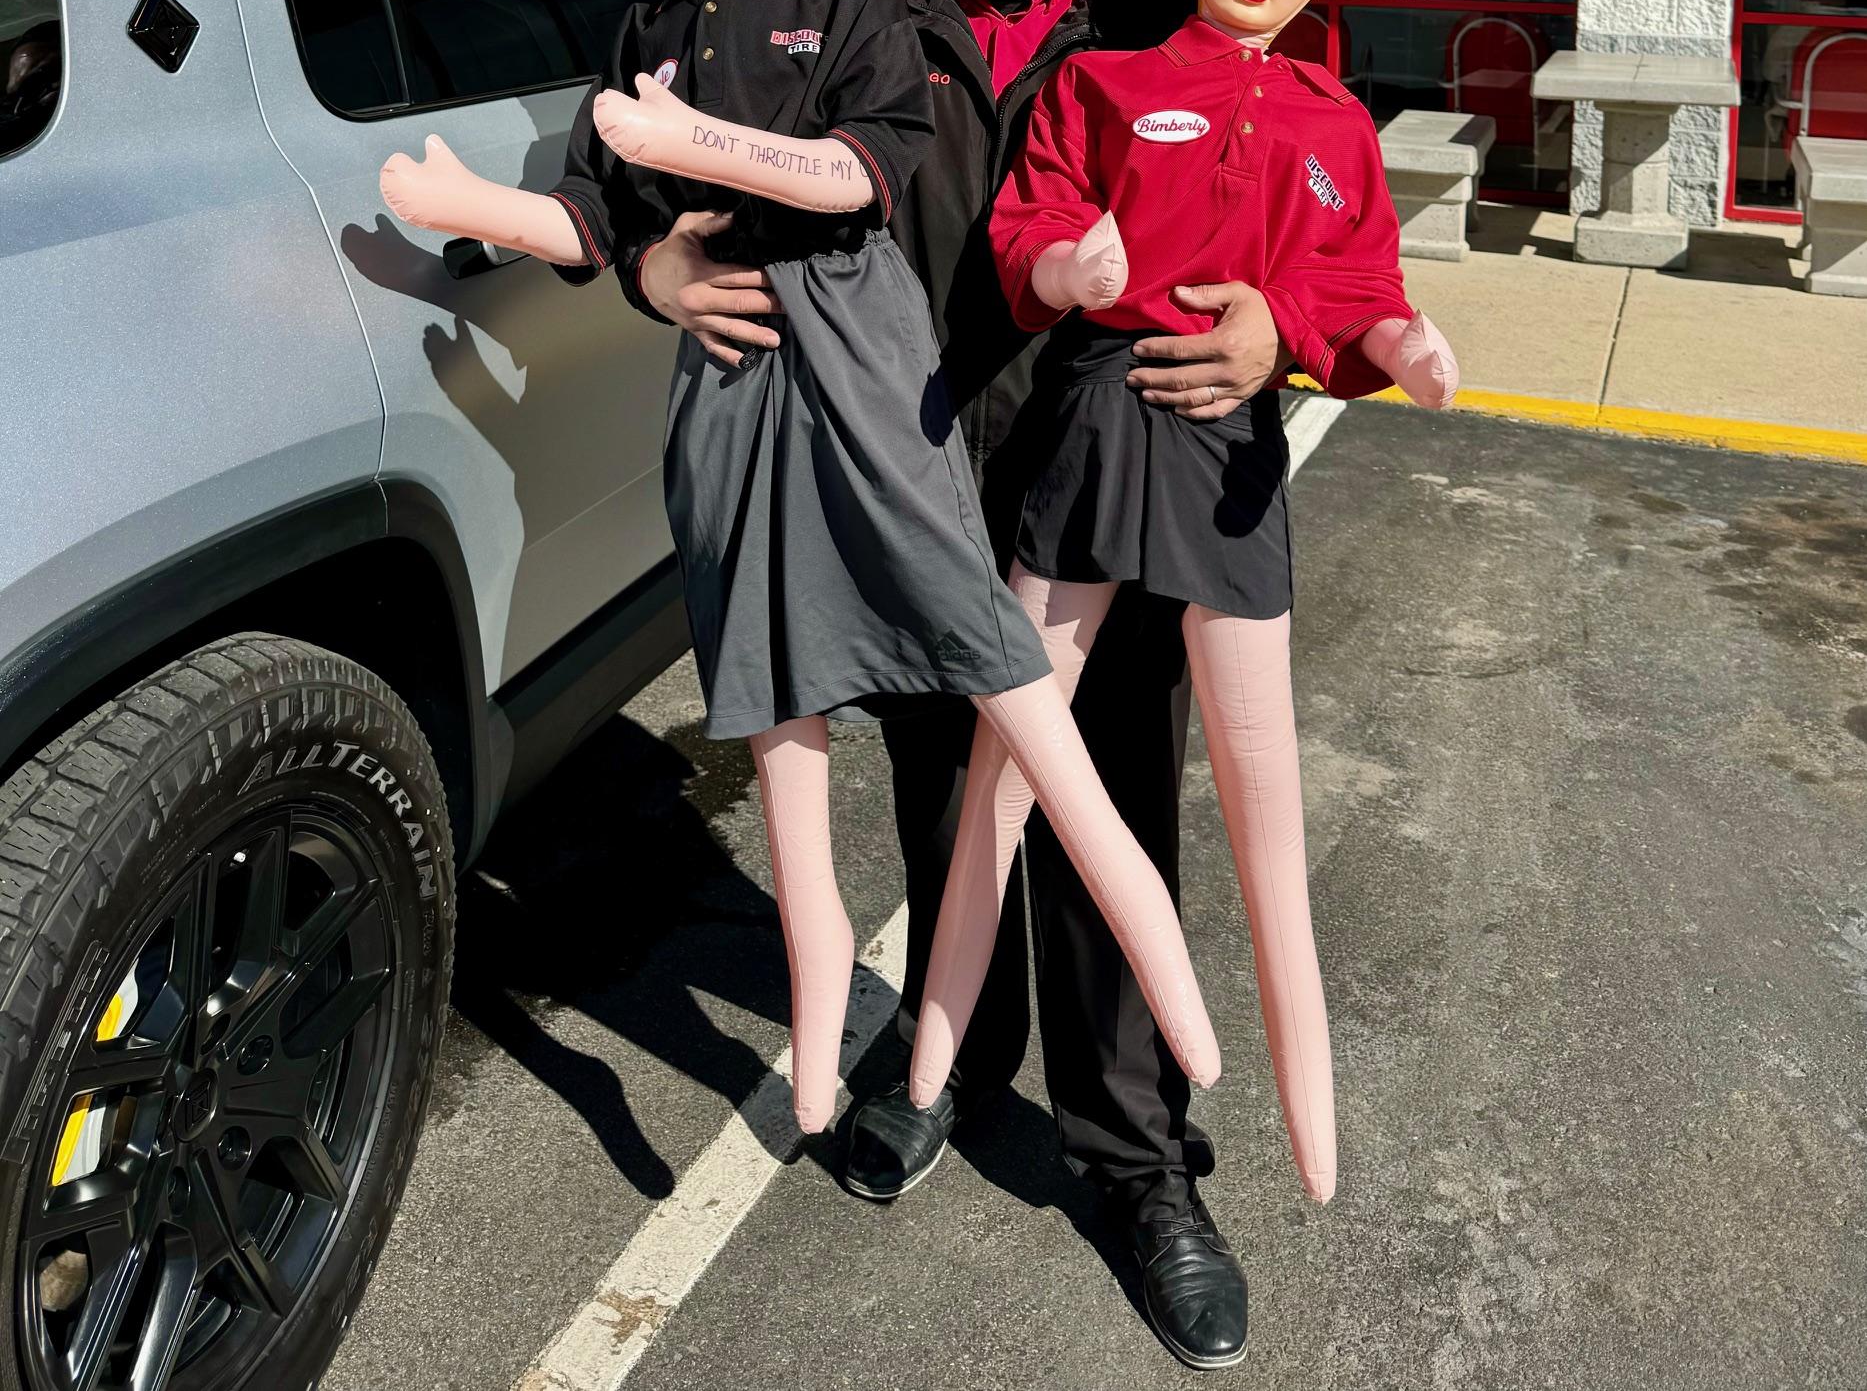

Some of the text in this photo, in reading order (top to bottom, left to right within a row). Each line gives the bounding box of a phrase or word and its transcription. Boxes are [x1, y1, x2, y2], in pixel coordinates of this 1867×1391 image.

[789, 43, 819, 53] TIRE
[1136, 117, 1209, 136] Bimberly
[692, 125, 740, 153] DON'T
[746, 143, 823, 176] THROTTLE
[830, 159, 852, 180] MY
[1305, 154, 1345, 210] DISCOUNT
